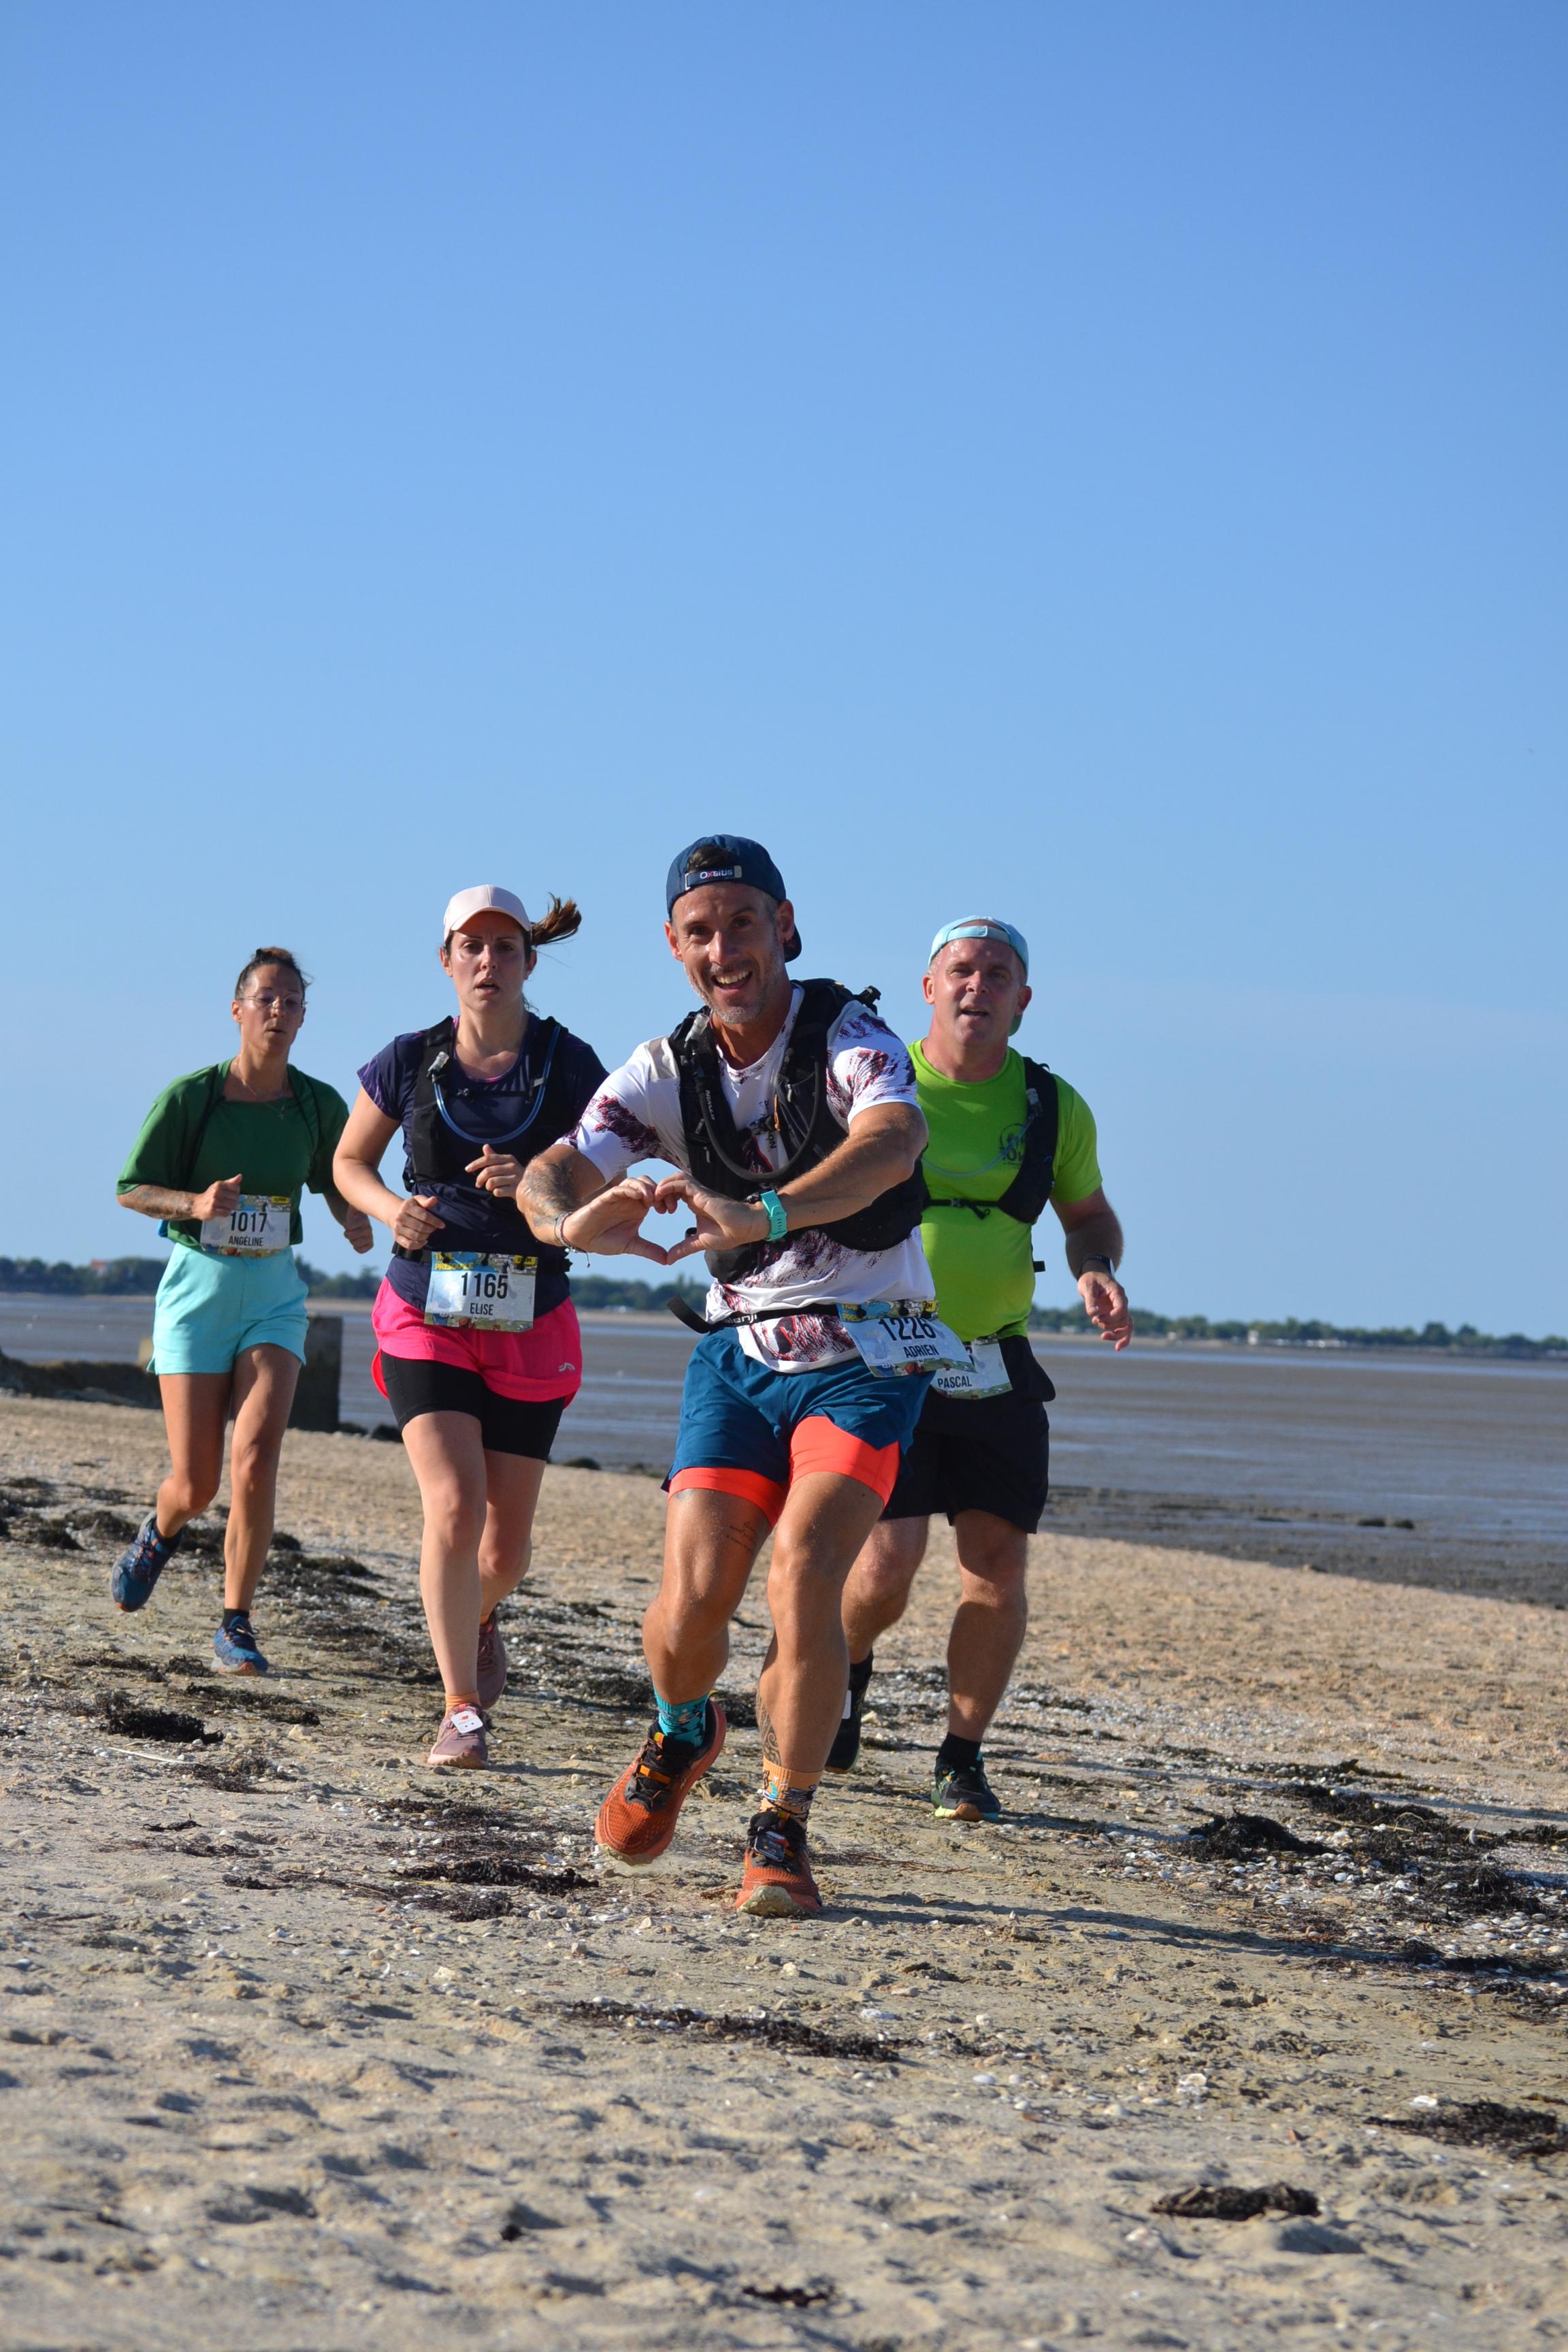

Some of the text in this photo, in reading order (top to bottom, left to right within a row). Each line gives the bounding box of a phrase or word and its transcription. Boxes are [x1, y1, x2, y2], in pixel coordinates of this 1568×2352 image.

[700, 868, 733, 879] Oxsitis
[230, 1211, 267, 1232] 1017
[461, 1272, 508, 1299] 1165
[470, 1303, 494, 1316] ELISE
[878, 1317, 936, 1341] 1226
[902, 1344, 940, 1359] ADRIEN
[937, 1375, 973, 1389] PASCAL
